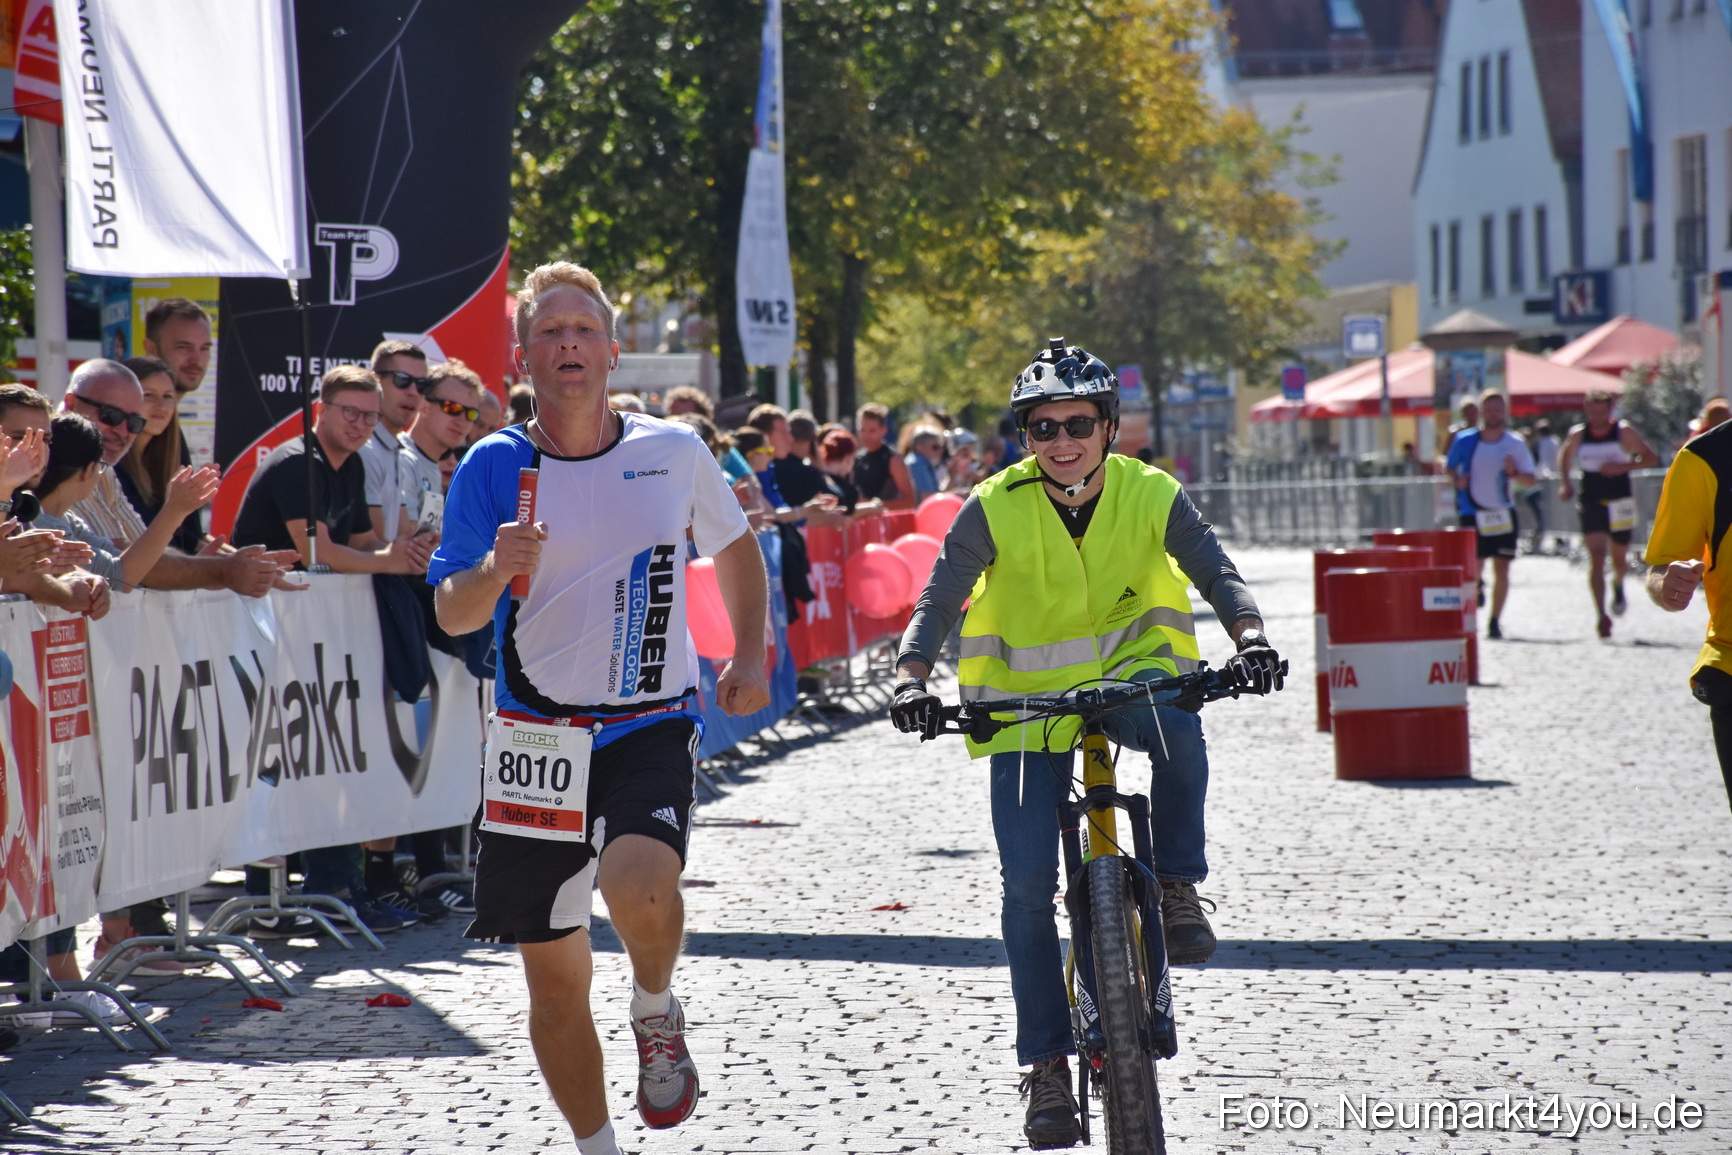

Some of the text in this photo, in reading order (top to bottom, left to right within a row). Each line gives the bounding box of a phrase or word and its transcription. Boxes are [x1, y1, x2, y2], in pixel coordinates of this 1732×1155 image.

[320, 229, 346, 240] Team
[259, 374, 287, 392] 100
[1072, 376, 1112, 395] BELL
[517, 489, 532, 524] 8010
[634, 544, 677, 696] HUBER
[607, 579, 625, 693] WASTE WATER Solutions
[623, 576, 646, 692] TECHNOLOGY
[512, 730, 559, 747] BOCK
[498, 750, 572, 792] 8010
[502, 790, 552, 804] PARTL Neumarkt
[501, 805, 558, 827] Huber SE
[651, 811, 680, 832] adidas
